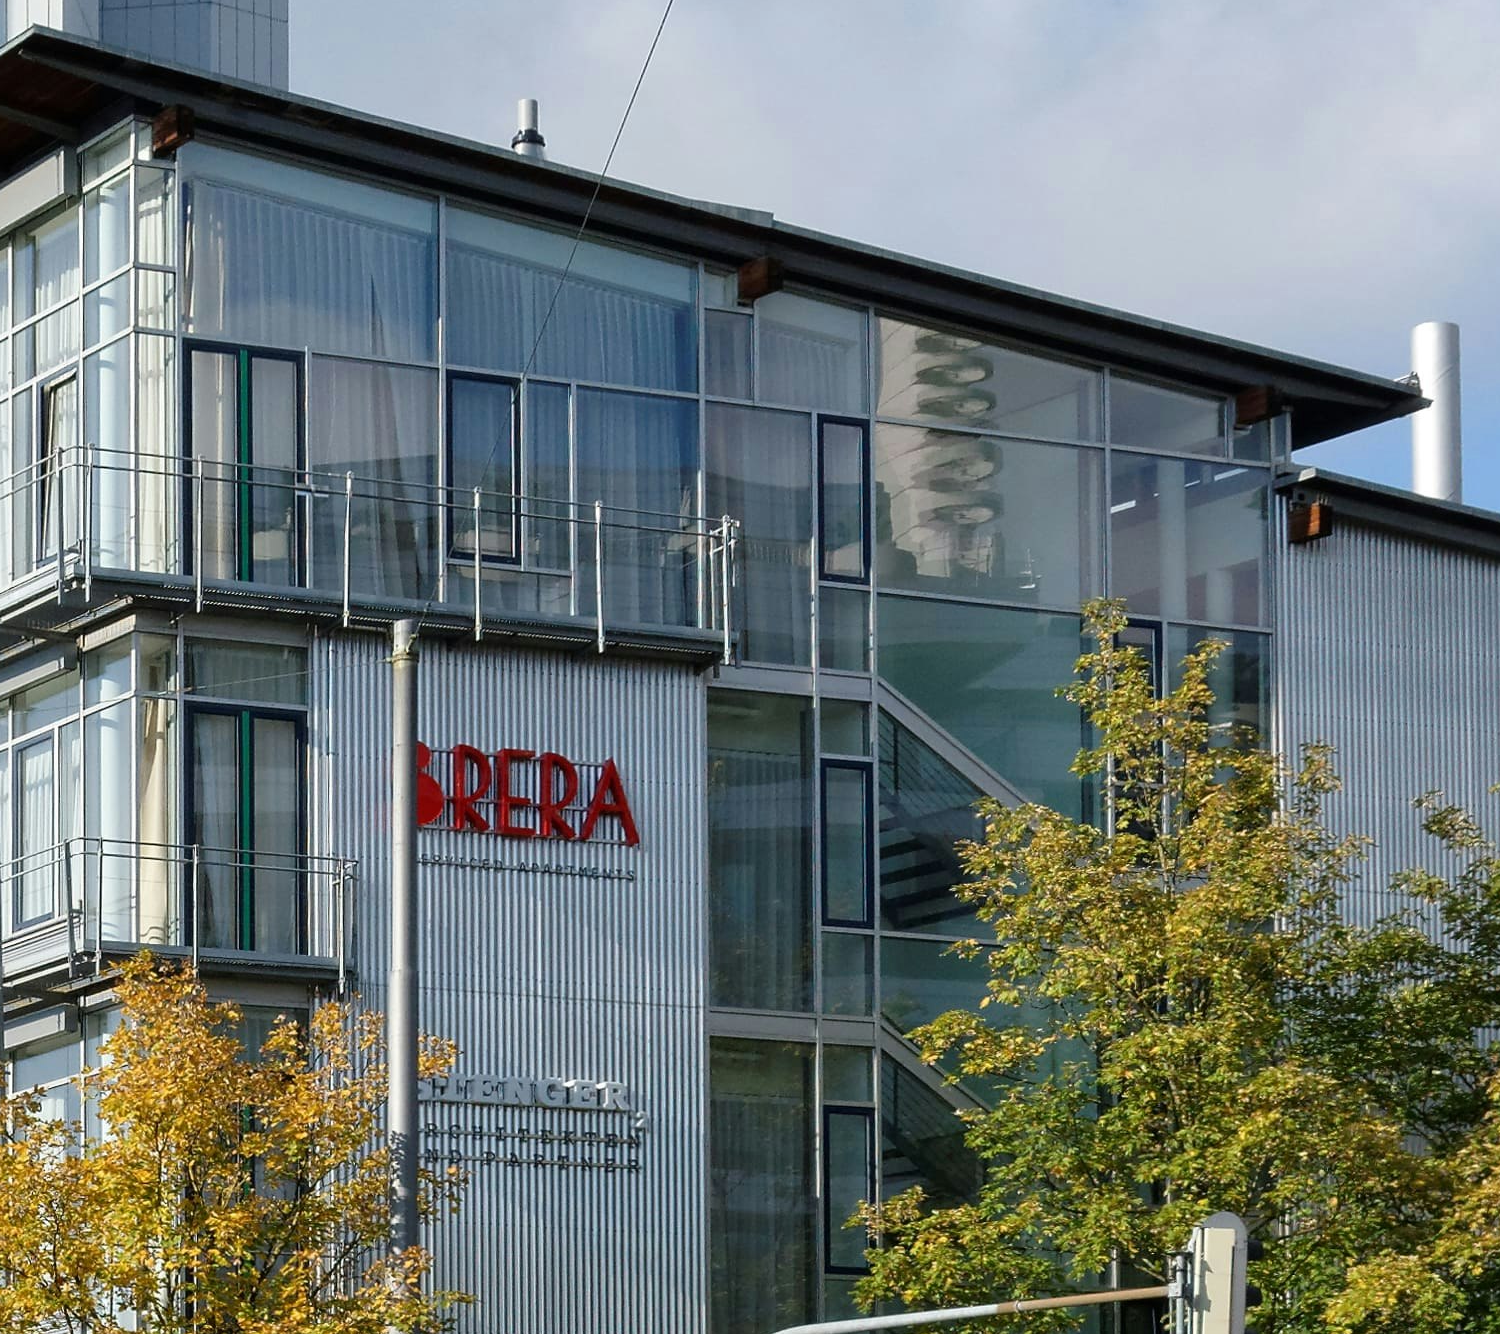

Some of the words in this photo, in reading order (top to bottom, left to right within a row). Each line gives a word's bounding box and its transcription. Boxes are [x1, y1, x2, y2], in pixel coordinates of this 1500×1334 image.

[420, 854, 504, 872] ERVICED
[425, 1122, 641, 1148] RCHITEKTEN
[425, 1148, 462, 1165] ND
[484, 1151, 641, 1174] PARTNER
